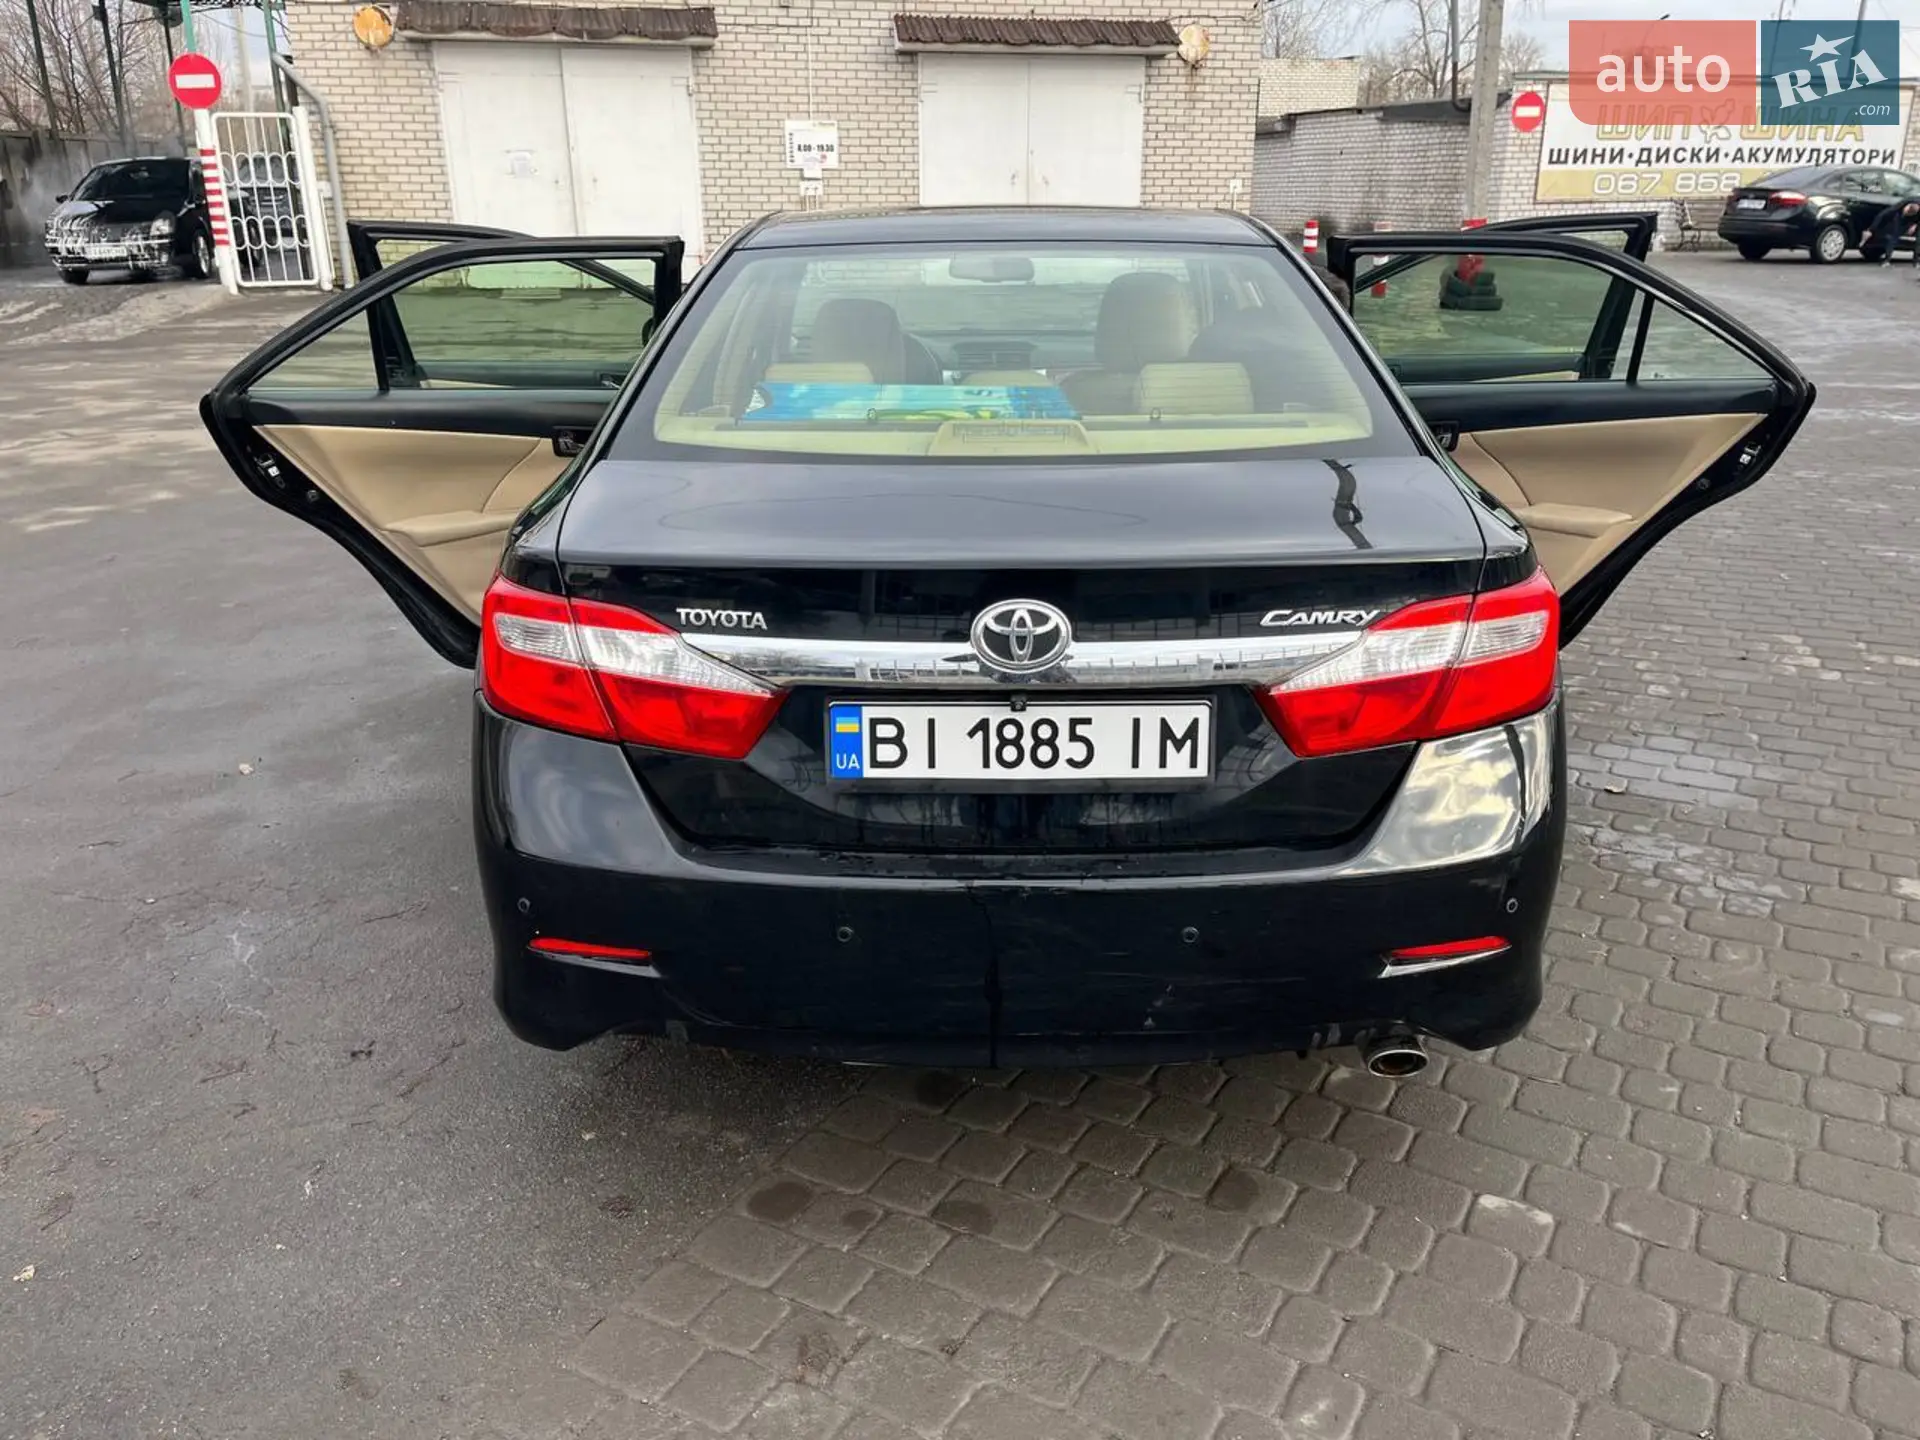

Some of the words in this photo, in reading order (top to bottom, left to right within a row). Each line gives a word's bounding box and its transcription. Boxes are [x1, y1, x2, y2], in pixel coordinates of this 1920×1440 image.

[1594, 171, 1661, 196] 067
[676, 607, 769, 631] TOYOTA
[868, 716, 936, 770] BI
[965, 716, 1096, 770] 1885
[1131, 716, 1200, 770] IM
[836, 754, 861, 770] UA
